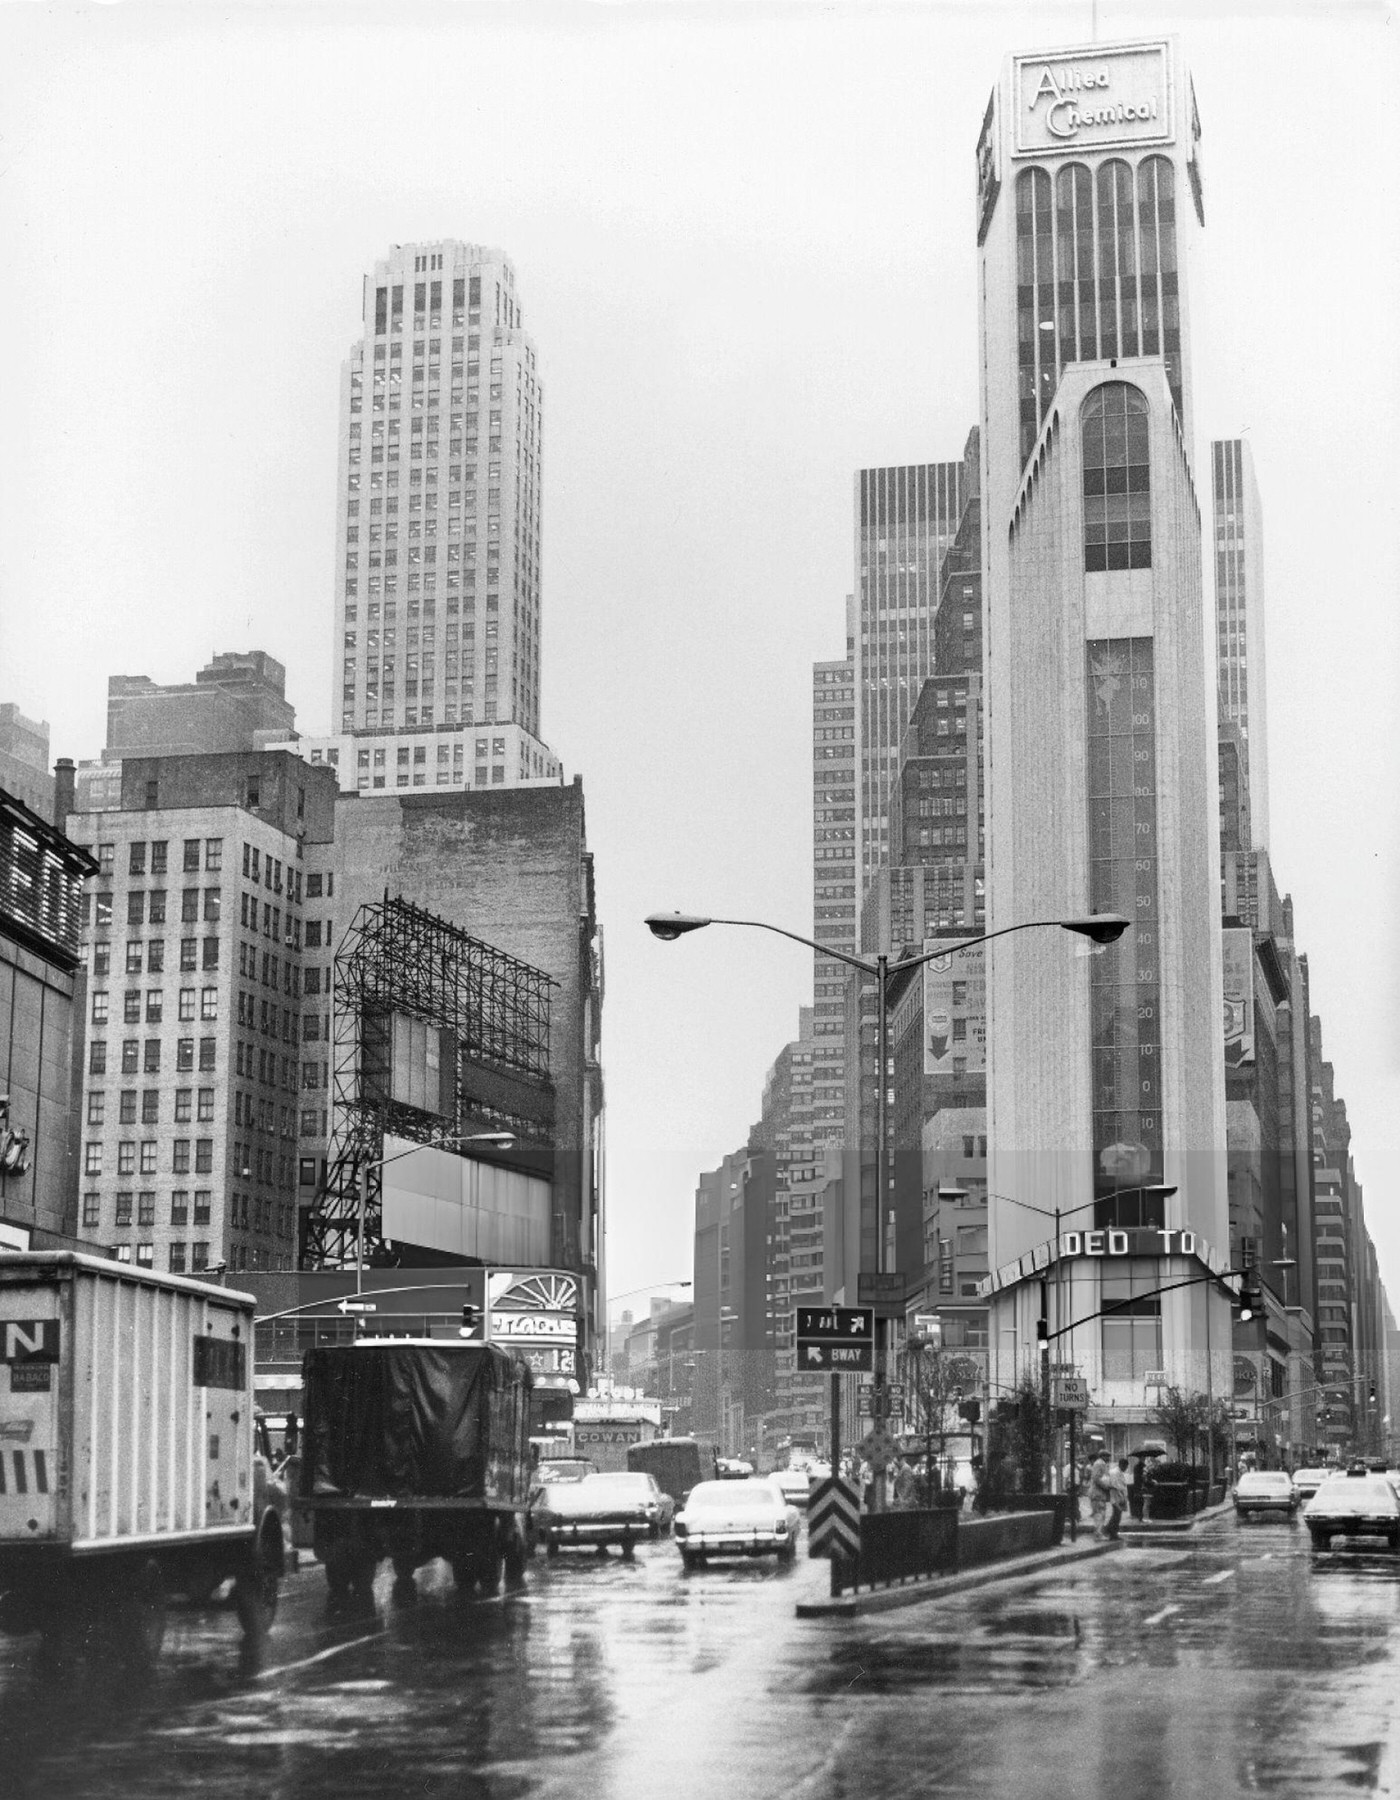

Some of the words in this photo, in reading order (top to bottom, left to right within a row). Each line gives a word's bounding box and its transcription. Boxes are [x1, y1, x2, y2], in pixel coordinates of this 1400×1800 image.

[1028, 65, 1110, 111] Allied
[1046, 96, 1158, 138] Chemical
[1135, 751, 1149, 761] 90
[1135, 822, 1150, 834] 70
[1135, 860, 1150, 871] 60
[1136, 895, 1151, 907] 50
[1138, 933, 1152, 944] 40
[958, 947, 983, 959] Save
[1138, 970, 1153, 981] 30
[1138, 1007, 1153, 1018] 20
[1140, 1044, 1153, 1055] 10
[1142, 1080, 1151, 1092] 0
[1142, 1118, 1154, 1129] 10
[1157, 1229, 1196, 1254] TO
[831, 1348, 862, 1361] BWAY
[1064, 1383, 1078, 1392] NO
[1059, 1393, 1085, 1402] TURNS
[578, 1433, 638, 1442] COWAN
